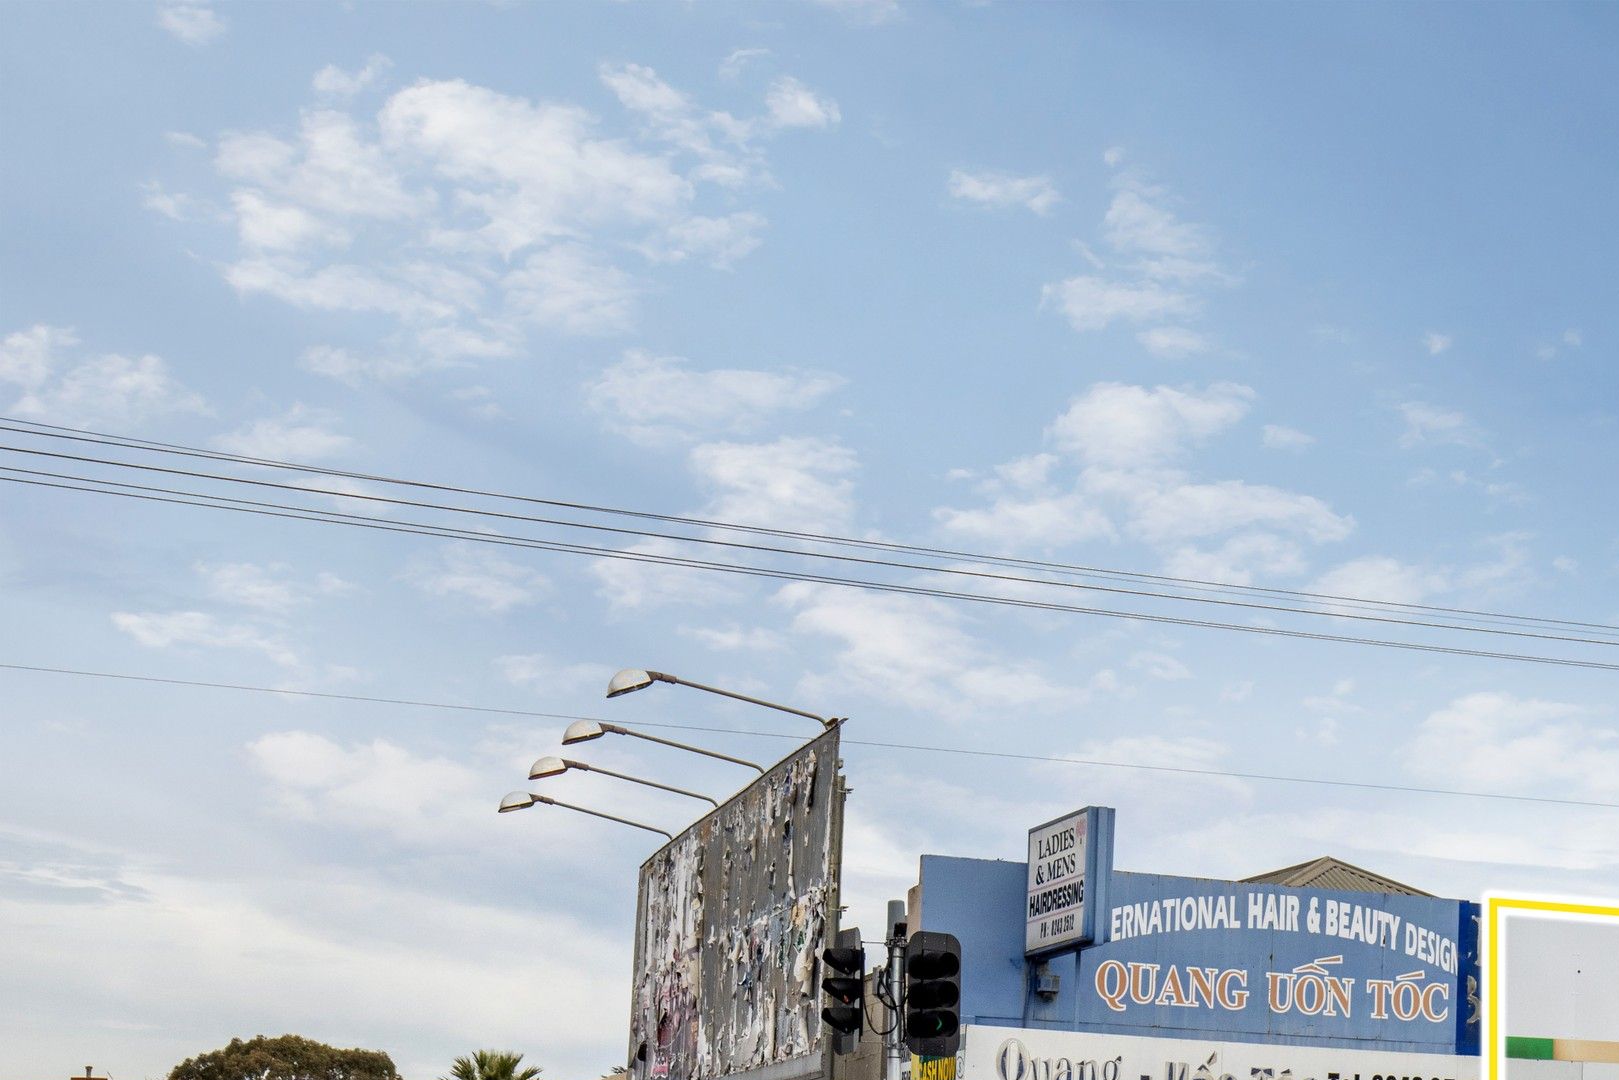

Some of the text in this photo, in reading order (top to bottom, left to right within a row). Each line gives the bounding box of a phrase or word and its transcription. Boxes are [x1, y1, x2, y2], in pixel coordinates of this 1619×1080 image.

[1038, 827, 1075, 860] LADIES
[1035, 853, 1076, 885] & MENS
[1029, 879, 1084, 918] HAIRDRESSING
[1110, 895, 1241, 943] ERNATIONAL
[1247, 893, 1300, 932] HAIR
[1306, 896, 1321, 934] &
[1325, 899, 1401, 951] BEAUTY
[1094, 954, 1449, 1023] QUANG UỐN TÓC
